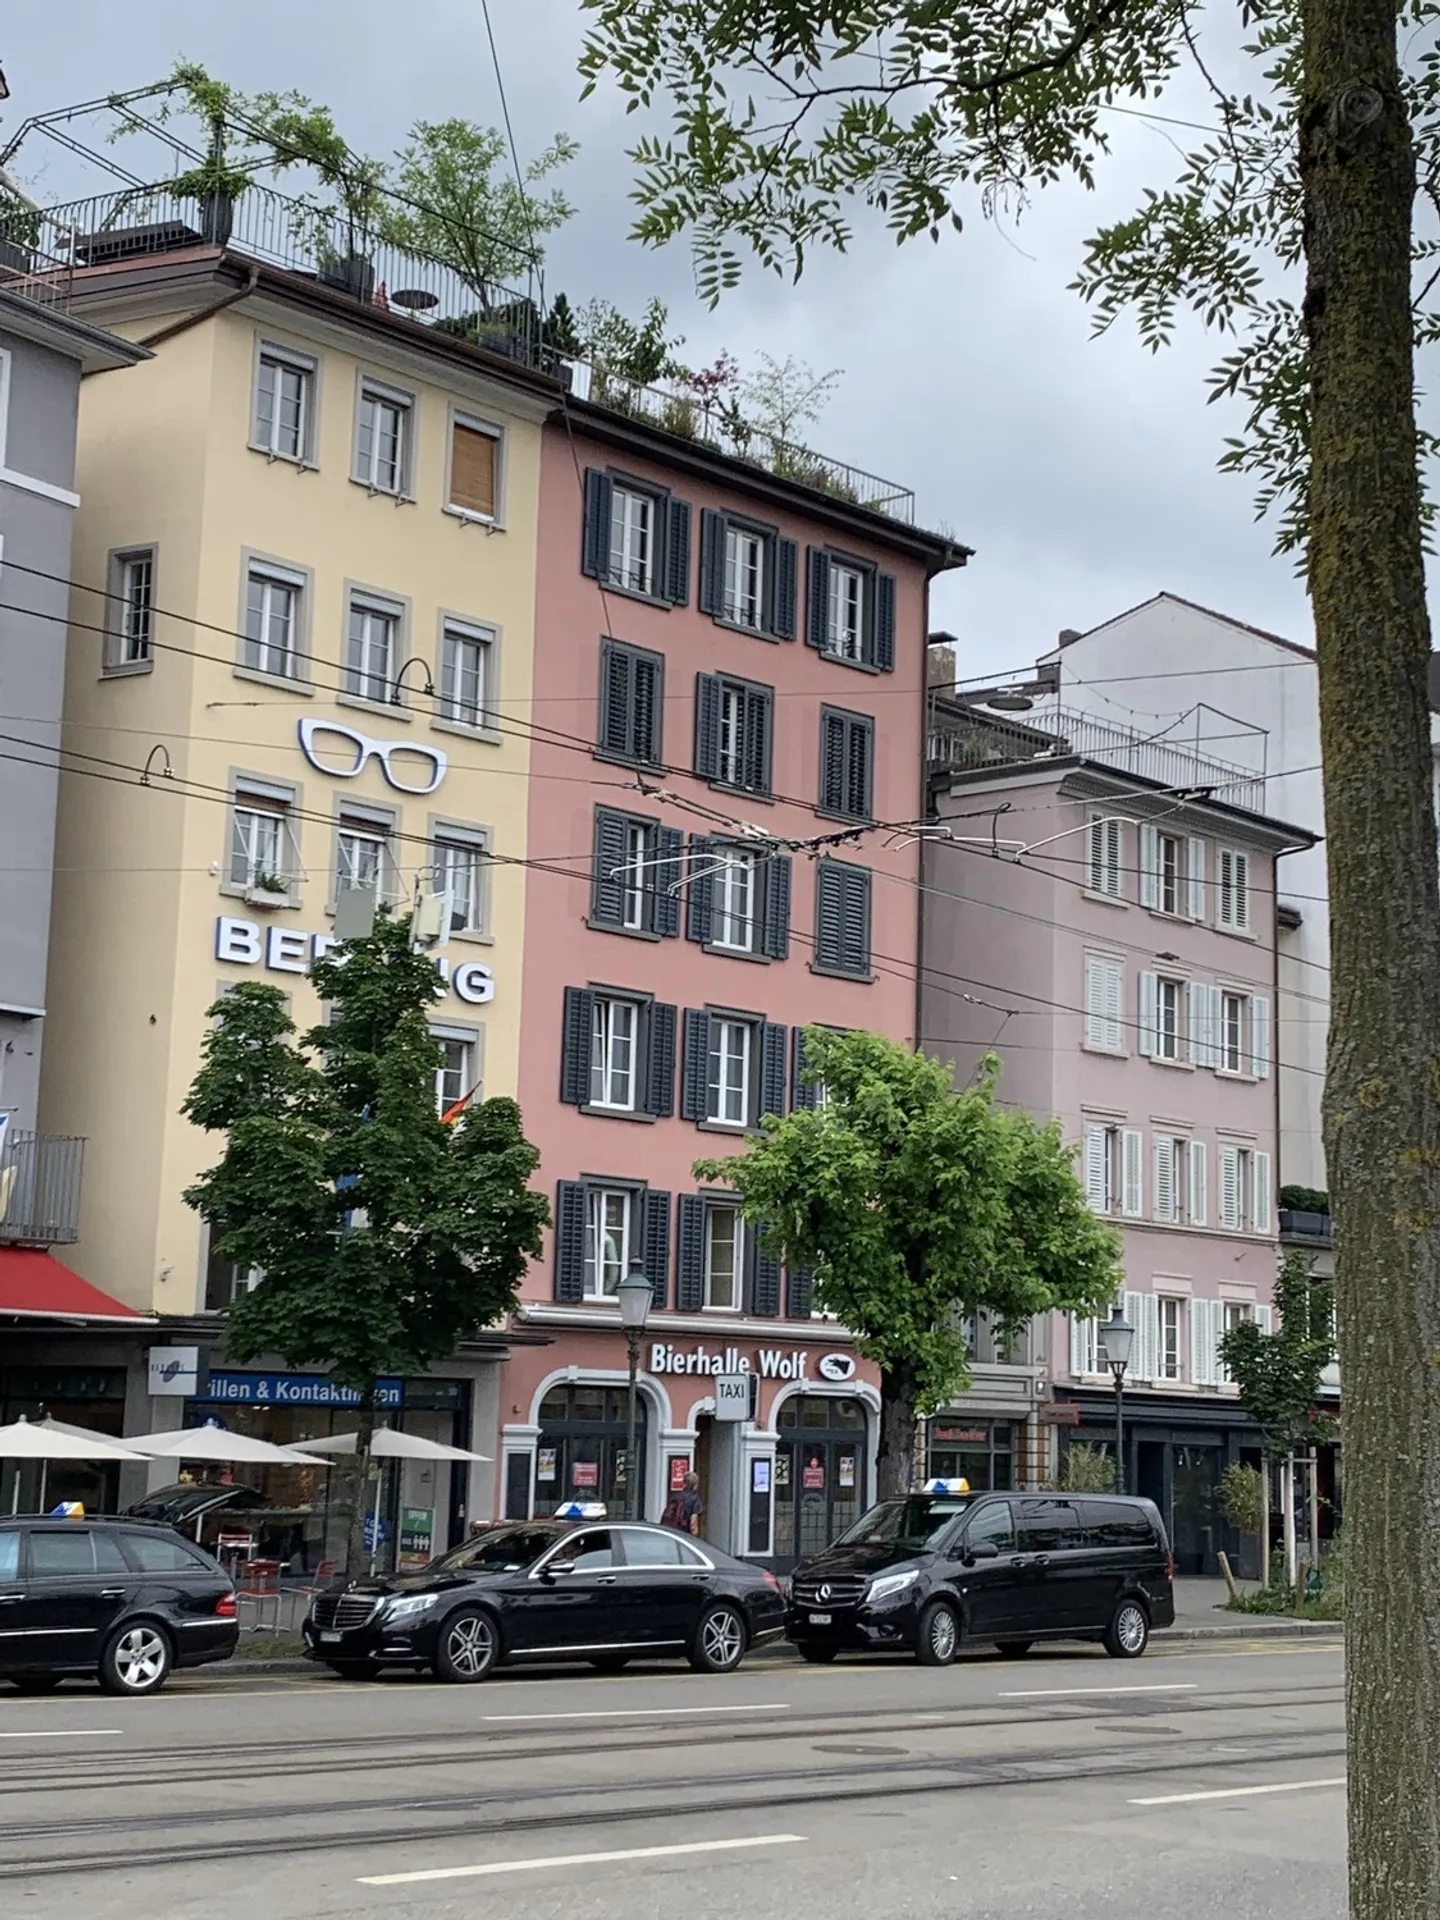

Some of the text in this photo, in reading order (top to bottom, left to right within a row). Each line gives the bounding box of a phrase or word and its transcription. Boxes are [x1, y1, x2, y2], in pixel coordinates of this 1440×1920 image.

[649, 1343, 808, 1379] Bierhalle Wolf
[256, 1380, 270, 1399] &
[276, 1380, 400, 1402] Kontaktlien
[719, 1383, 745, 1399] TAXI
